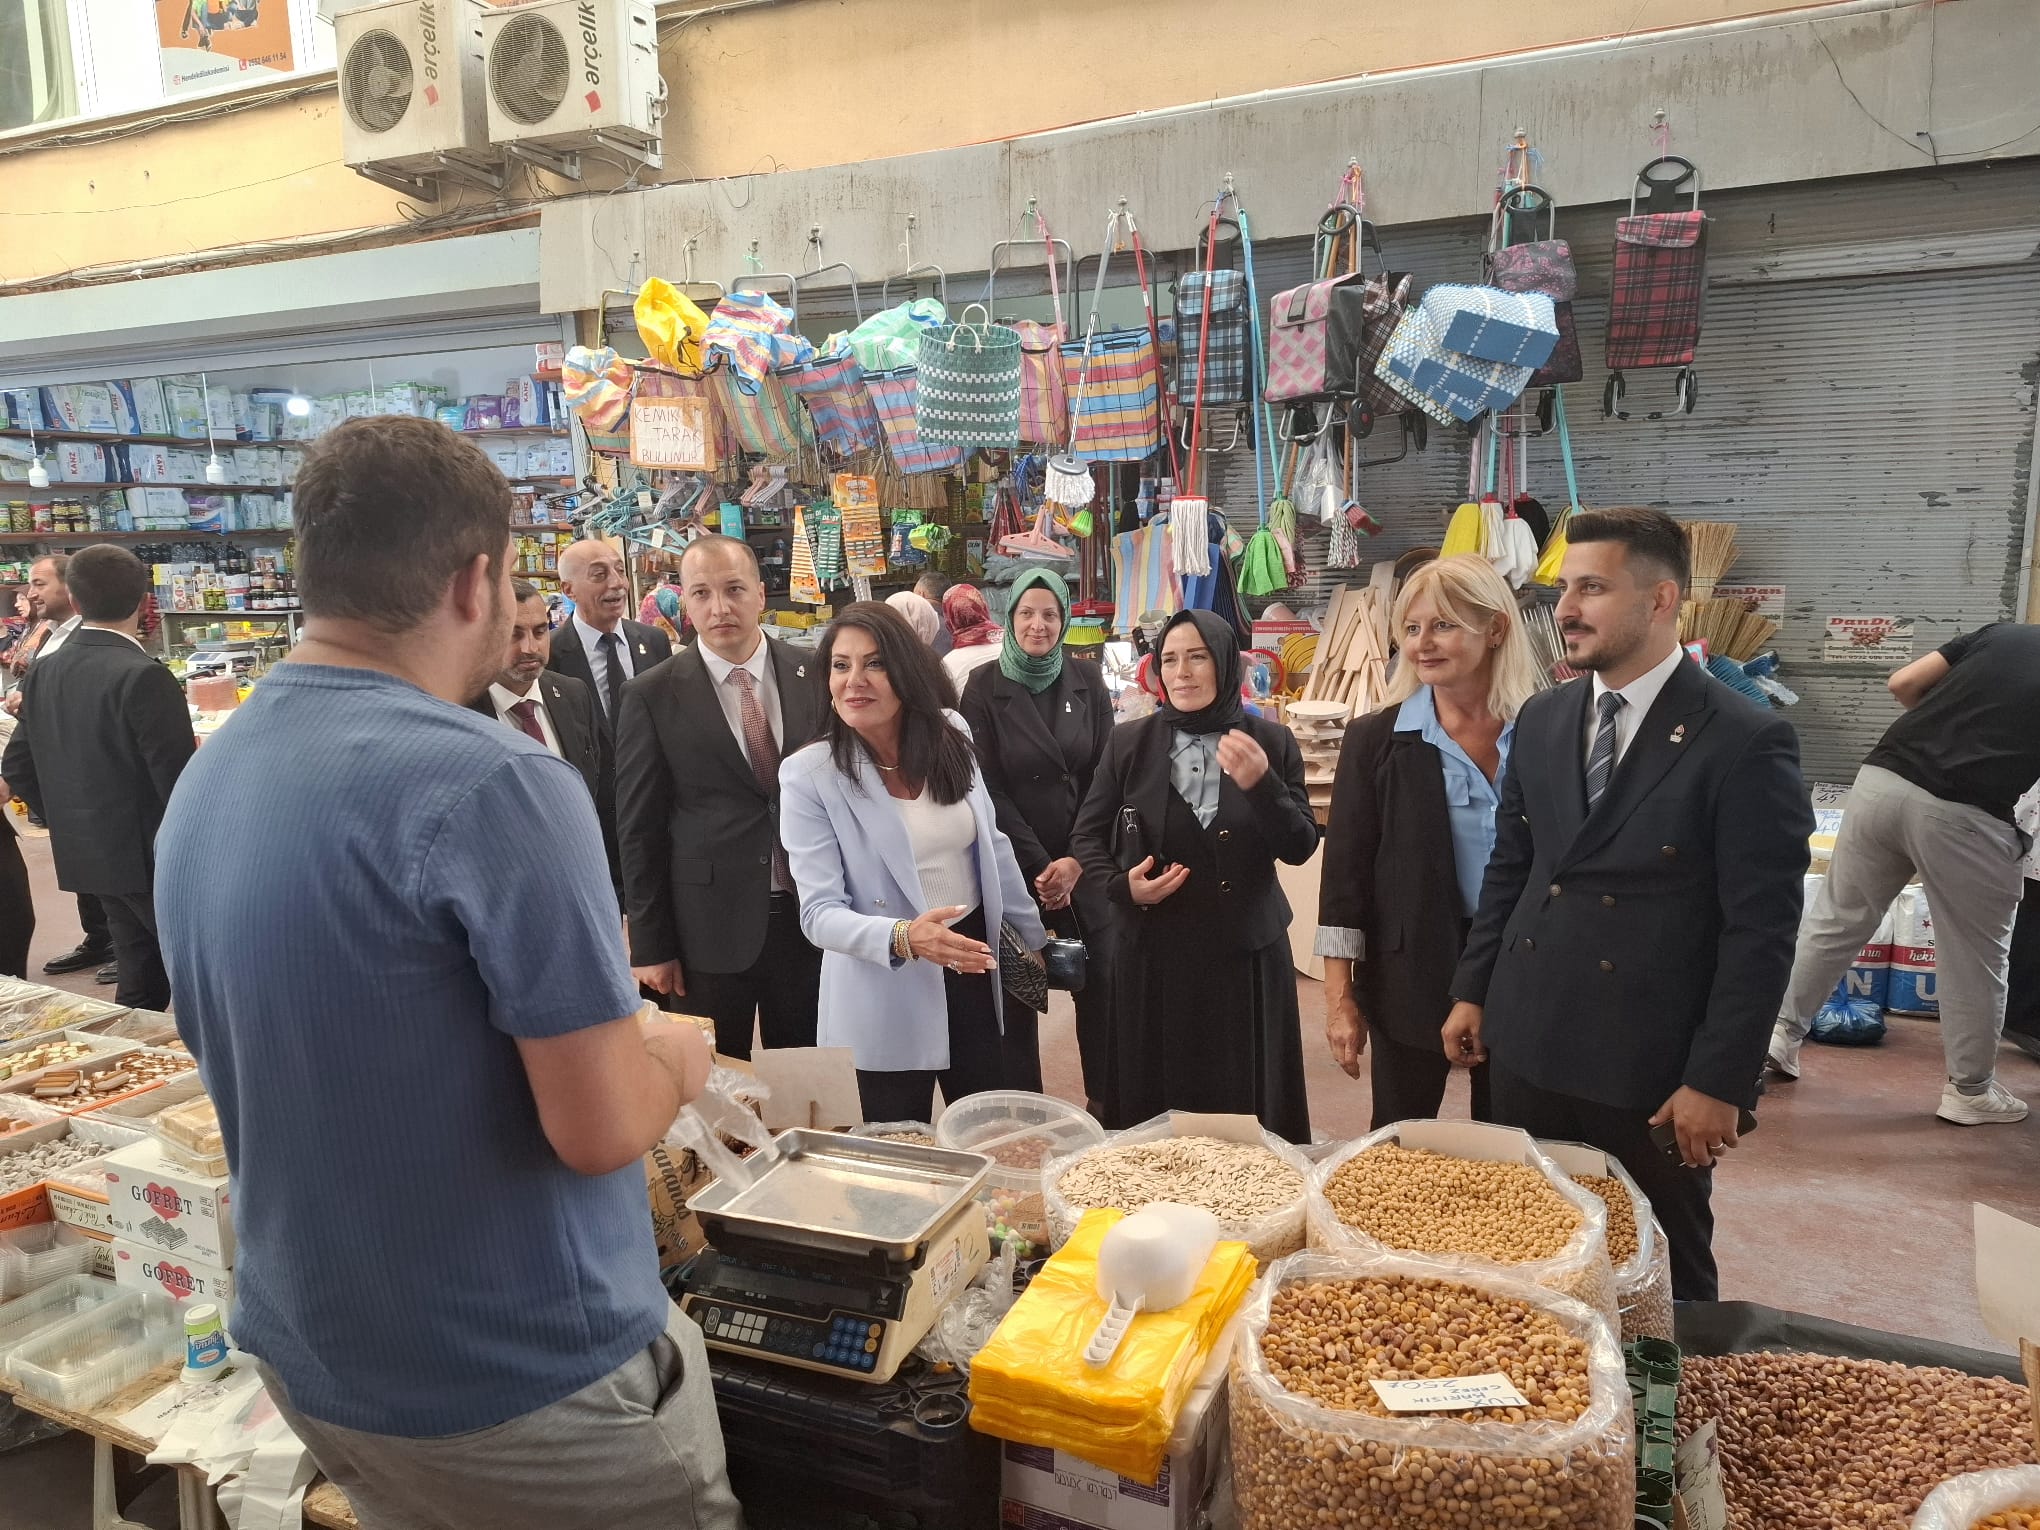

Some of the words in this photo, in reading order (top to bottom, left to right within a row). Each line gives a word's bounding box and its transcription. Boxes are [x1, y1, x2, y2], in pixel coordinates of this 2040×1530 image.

[419, 1, 441, 80] arçelik
[577, 1, 602, 86] arçelik
[64, 401, 77, 423] KANZ
[111, 393, 121, 411] KANZ
[651, 426, 702, 441] TARAK
[69, 451, 78, 475] KANZ
[156, 454, 165, 476] KANZ
[641, 448, 698, 463] BULUNUR
[1816, 792, 1841, 804] 45
[1846, 969, 1873, 996] N
[131, 1185, 193, 1216] GOFRET
[142, 1262, 206, 1294] GOFRET
[851, 1353, 858, 1361] 3
